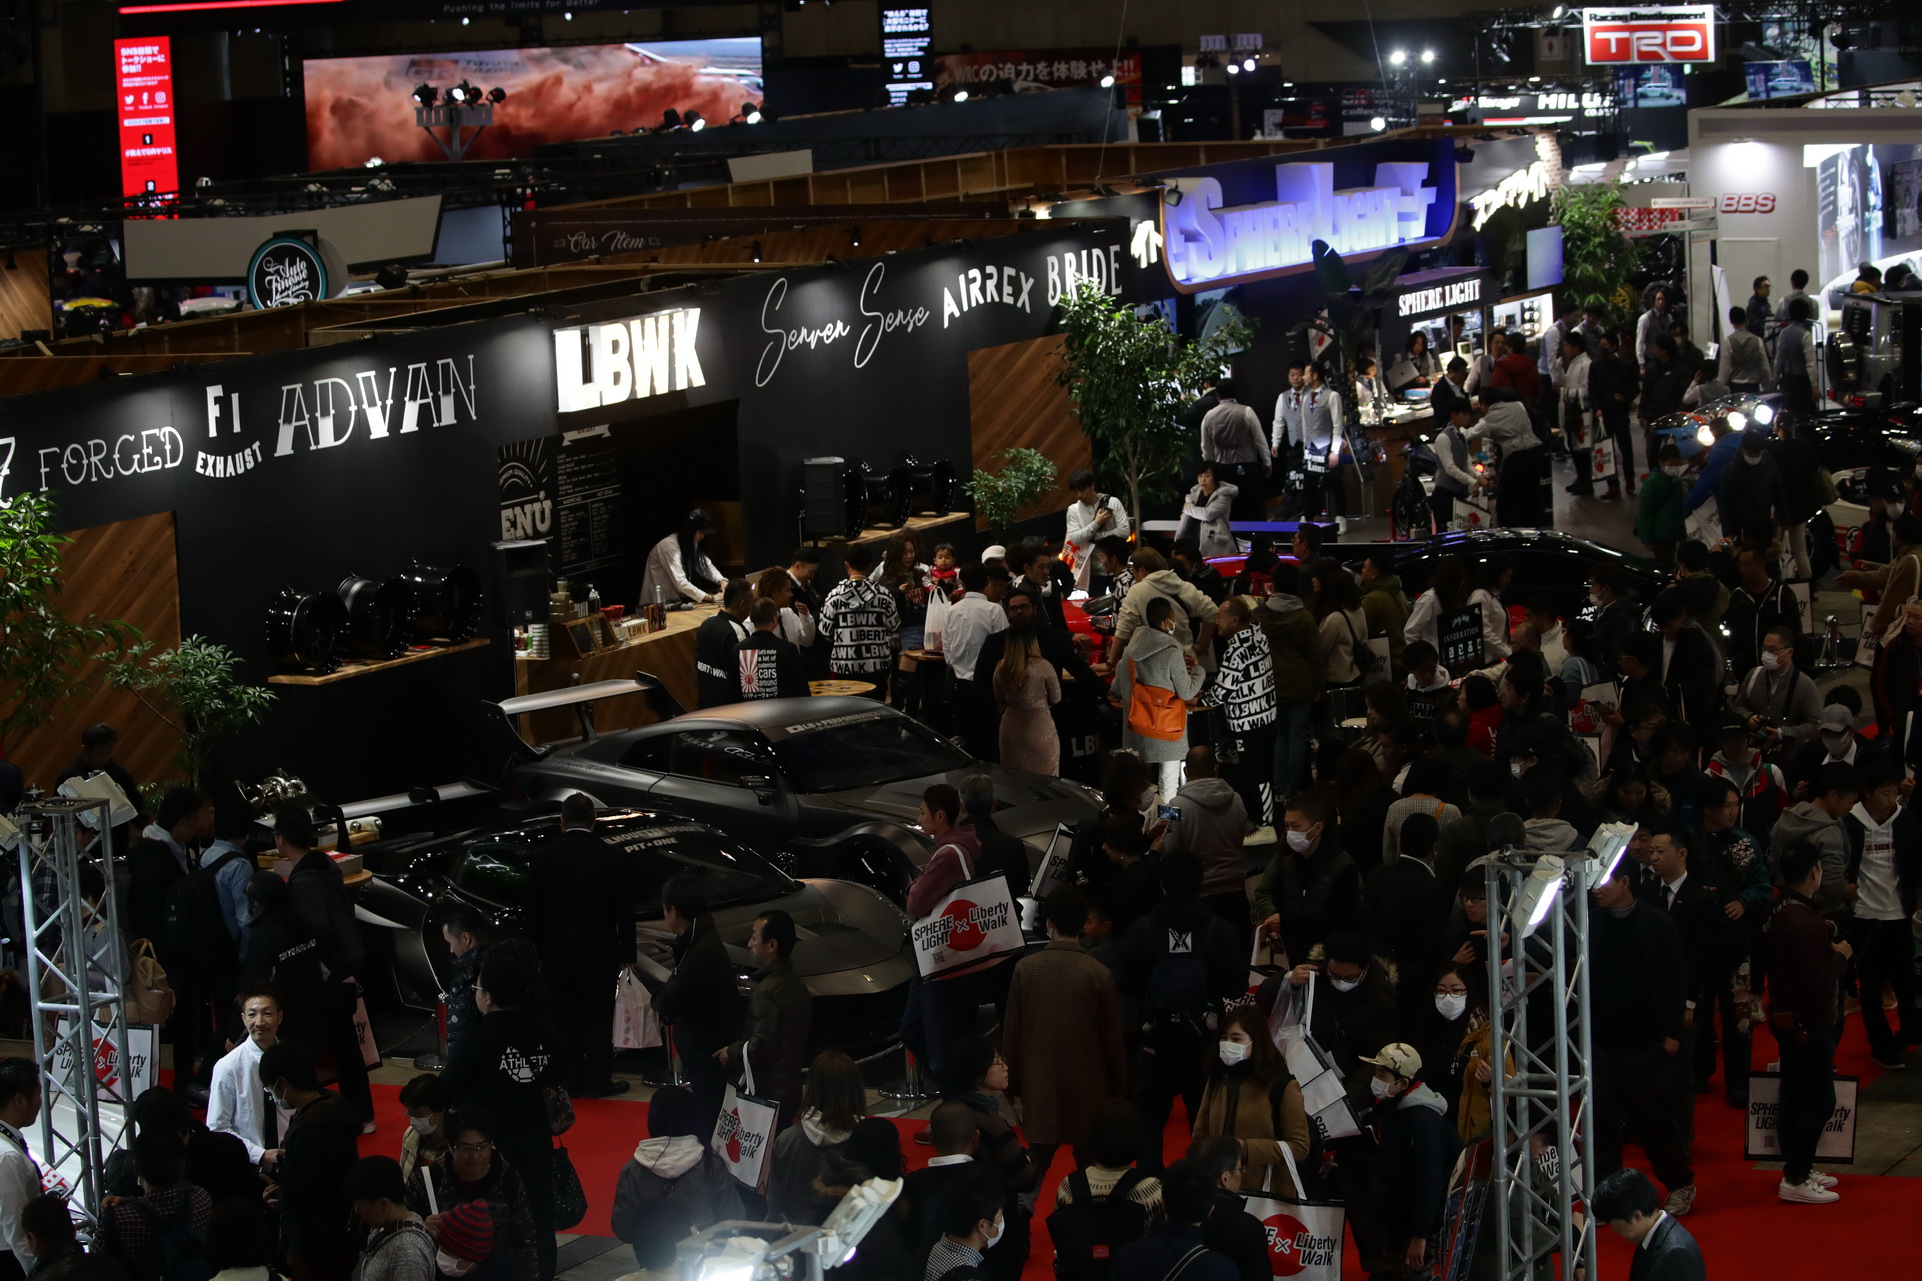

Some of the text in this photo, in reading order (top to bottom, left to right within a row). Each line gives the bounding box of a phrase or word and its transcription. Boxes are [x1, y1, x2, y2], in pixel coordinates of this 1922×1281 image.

[443, 4, 484, 13] Pushing
[489, 3, 506, 11] the
[510, 1, 541, 10] limits
[1589, 10, 1706, 23] Racing Development
[1594, 29, 1703, 62] TRD
[1720, 193, 1776, 214] BBS
[567, 231, 599, 252] Car
[1046, 243, 1122, 307] BRIDE
[942, 265, 1035, 329] AIRREX
[1398, 278, 1482, 317] SPHERE LIGHT
[854, 261, 930, 369] Sense
[554, 308, 707, 413] LBWK
[273, 354, 477, 457] ADVAN
[39, 426, 184, 492] FORGED
[195, 440, 262, 478] EXHAUST
[627, 621, 648, 638] LBWK
[839, 612, 877, 627] LBWK
[1443, 626, 1479, 643] INFORMATION
[758, 668, 777, 679] cars
[914, 915, 954, 942] SPHERE
[969, 902, 1009, 923] Liberty
[921, 914, 1008, 952] LIGHT Walk
[1295, 1232, 1337, 1253] Liberty
[1301, 1250, 1334, 1266] Walk
